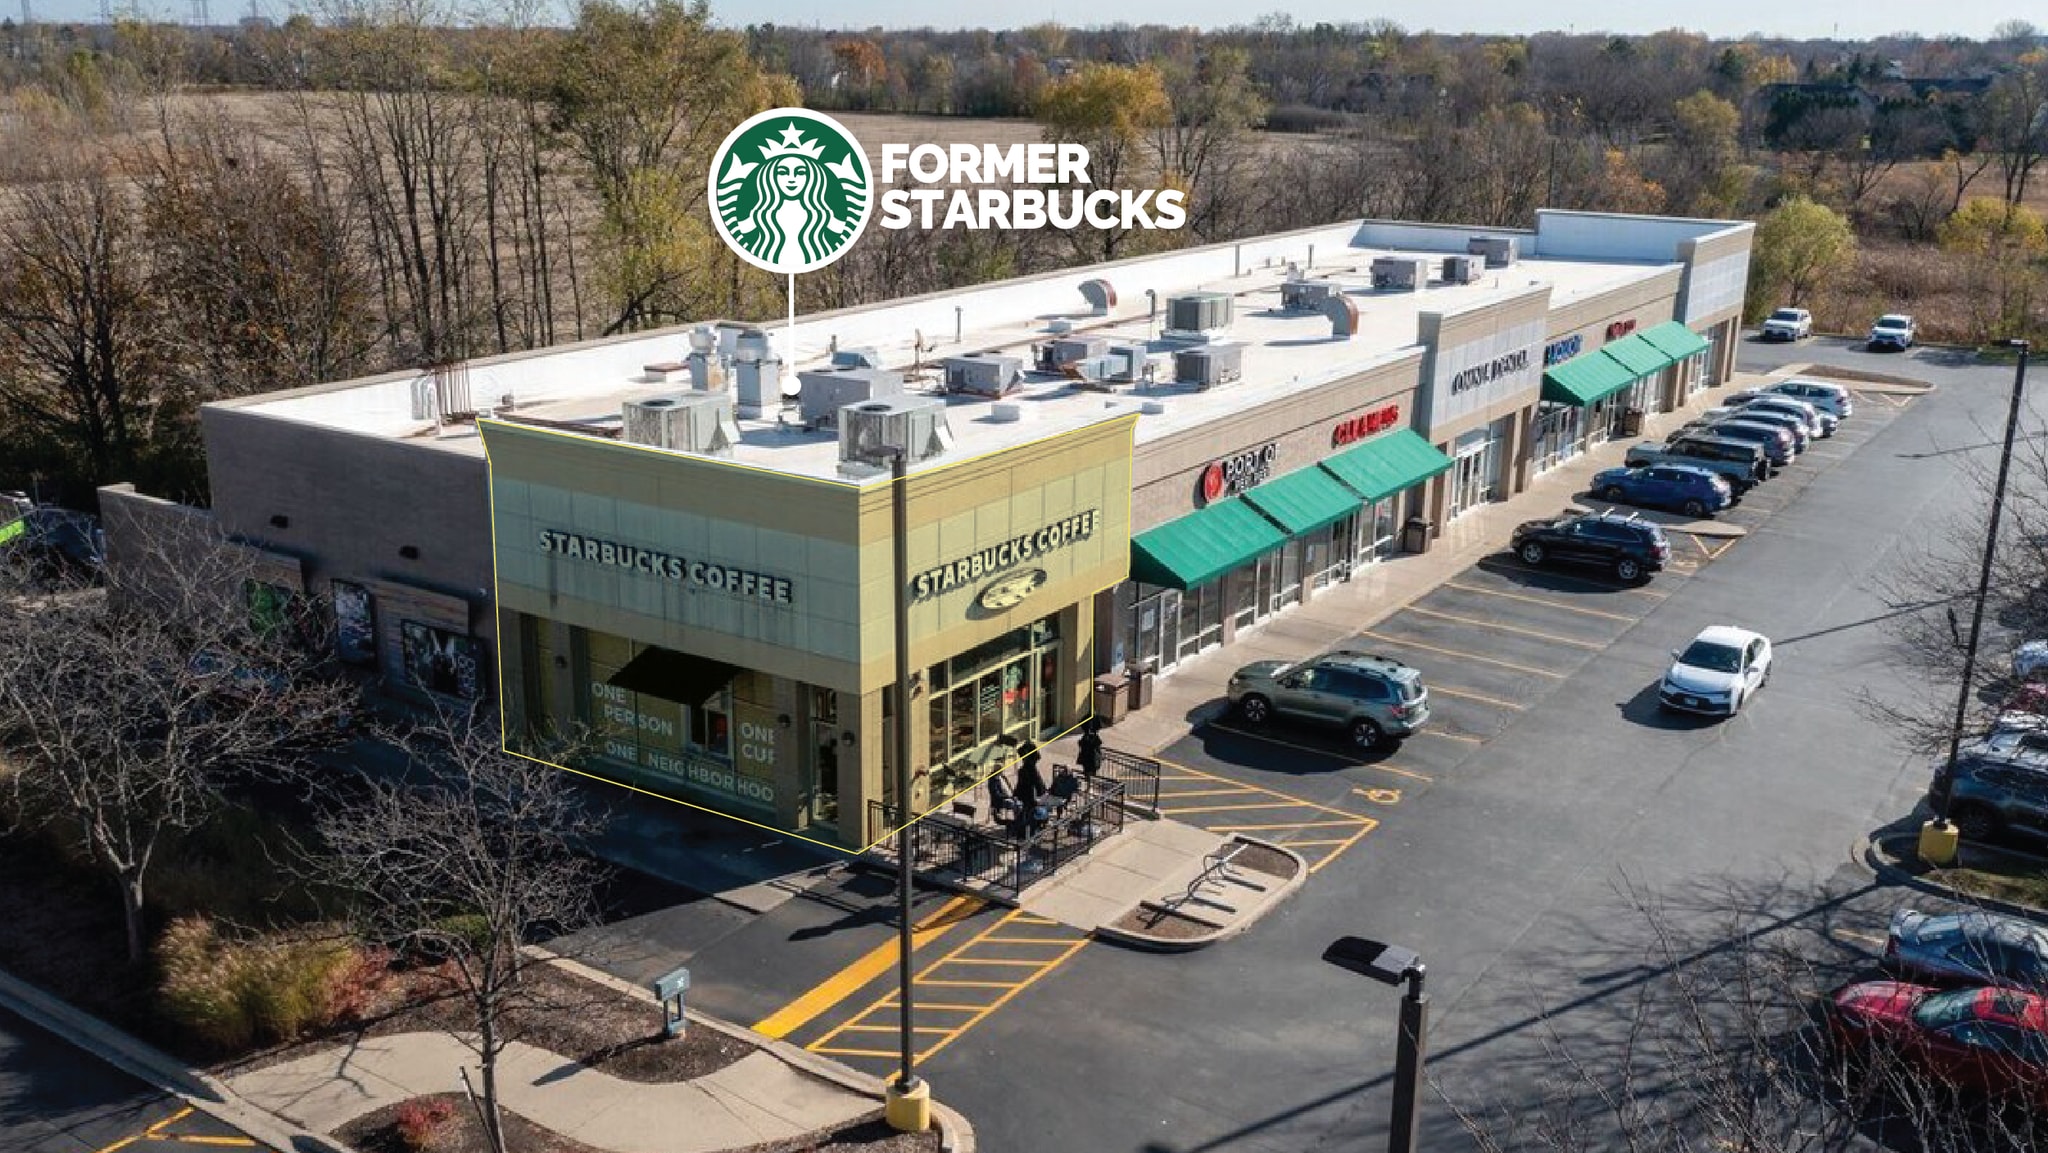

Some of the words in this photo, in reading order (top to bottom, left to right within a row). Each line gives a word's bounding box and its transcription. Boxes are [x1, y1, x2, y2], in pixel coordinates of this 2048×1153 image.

[540, 530, 684, 579] STARBUCKS
[690, 562, 792, 603] COFFEE
[915, 534, 1033, 598] STARBUCKS
[1037, 509, 1100, 550] COFFEE
[591, 681, 627, 701] ONE
[603, 705, 673, 737] PERSON
[605, 740, 637, 761] ONE
[649, 753, 774, 801] NEIGHBORHOO
